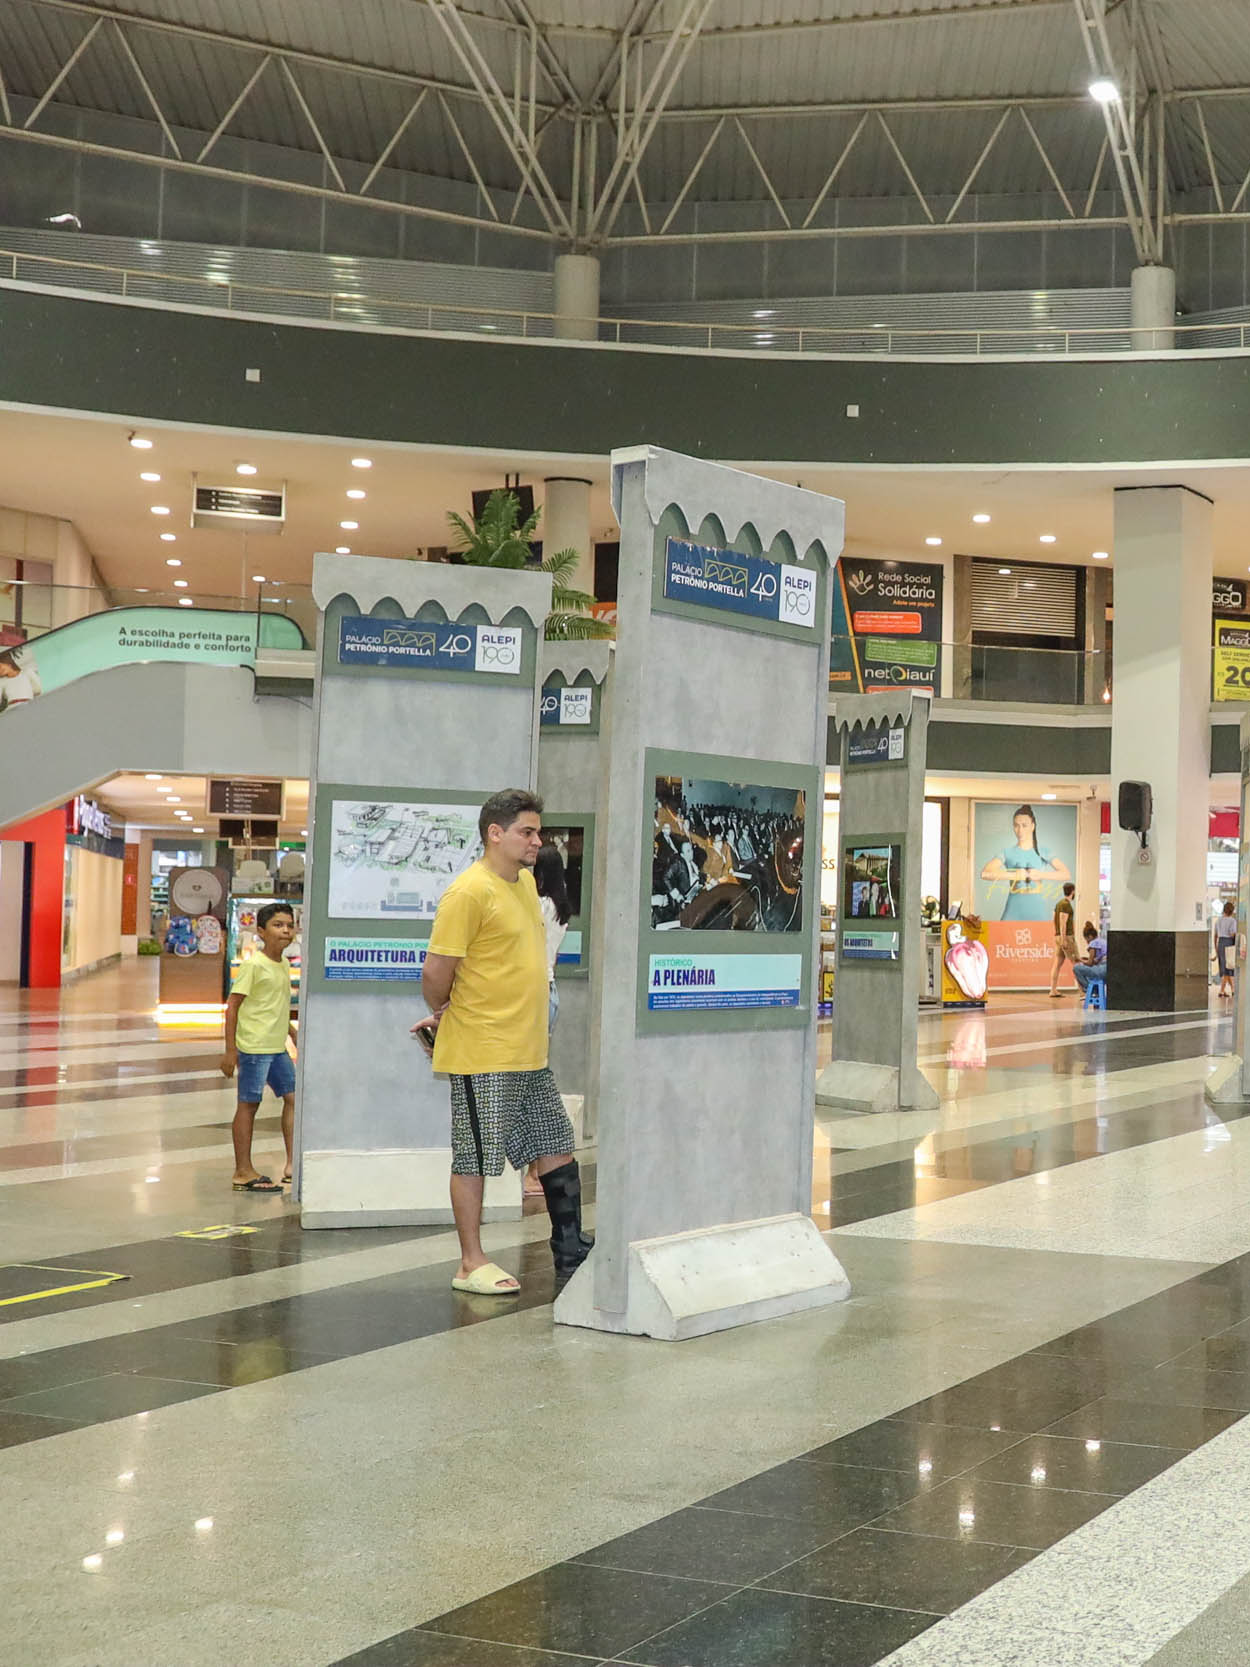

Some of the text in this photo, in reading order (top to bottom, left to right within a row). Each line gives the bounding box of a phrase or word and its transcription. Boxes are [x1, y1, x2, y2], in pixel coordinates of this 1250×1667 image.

[672, 562, 703, 576] PALÁCIO
[671, 574, 745, 598] PETRÔNIO PORTELLA
[784, 576, 812, 592] ALEPI
[878, 572, 931, 584] Rede Social
[750, 572, 777, 602] 40
[878, 583, 936, 599] Solidária
[783, 589, 811, 616] 190
[119, 627, 250, 645] A escolha perfeita para
[345, 633, 382, 645] PALÁCIO
[481, 635, 516, 645] ALEPI
[118, 637, 191, 650] durabilidade
[204, 643, 252, 653] conforto
[345, 643, 432, 657] PETRÔNIO PORTELLA
[439, 634, 472, 658] 40
[480, 645, 515, 665] 190
[564, 694, 588, 702] ALEPI
[329, 949, 417, 963] ARQUITETURA
[995, 944, 1055, 959] Riverside
[654, 958, 692, 967] HISTÓRICO
[653, 966, 715, 986] A PLENÁRIA
